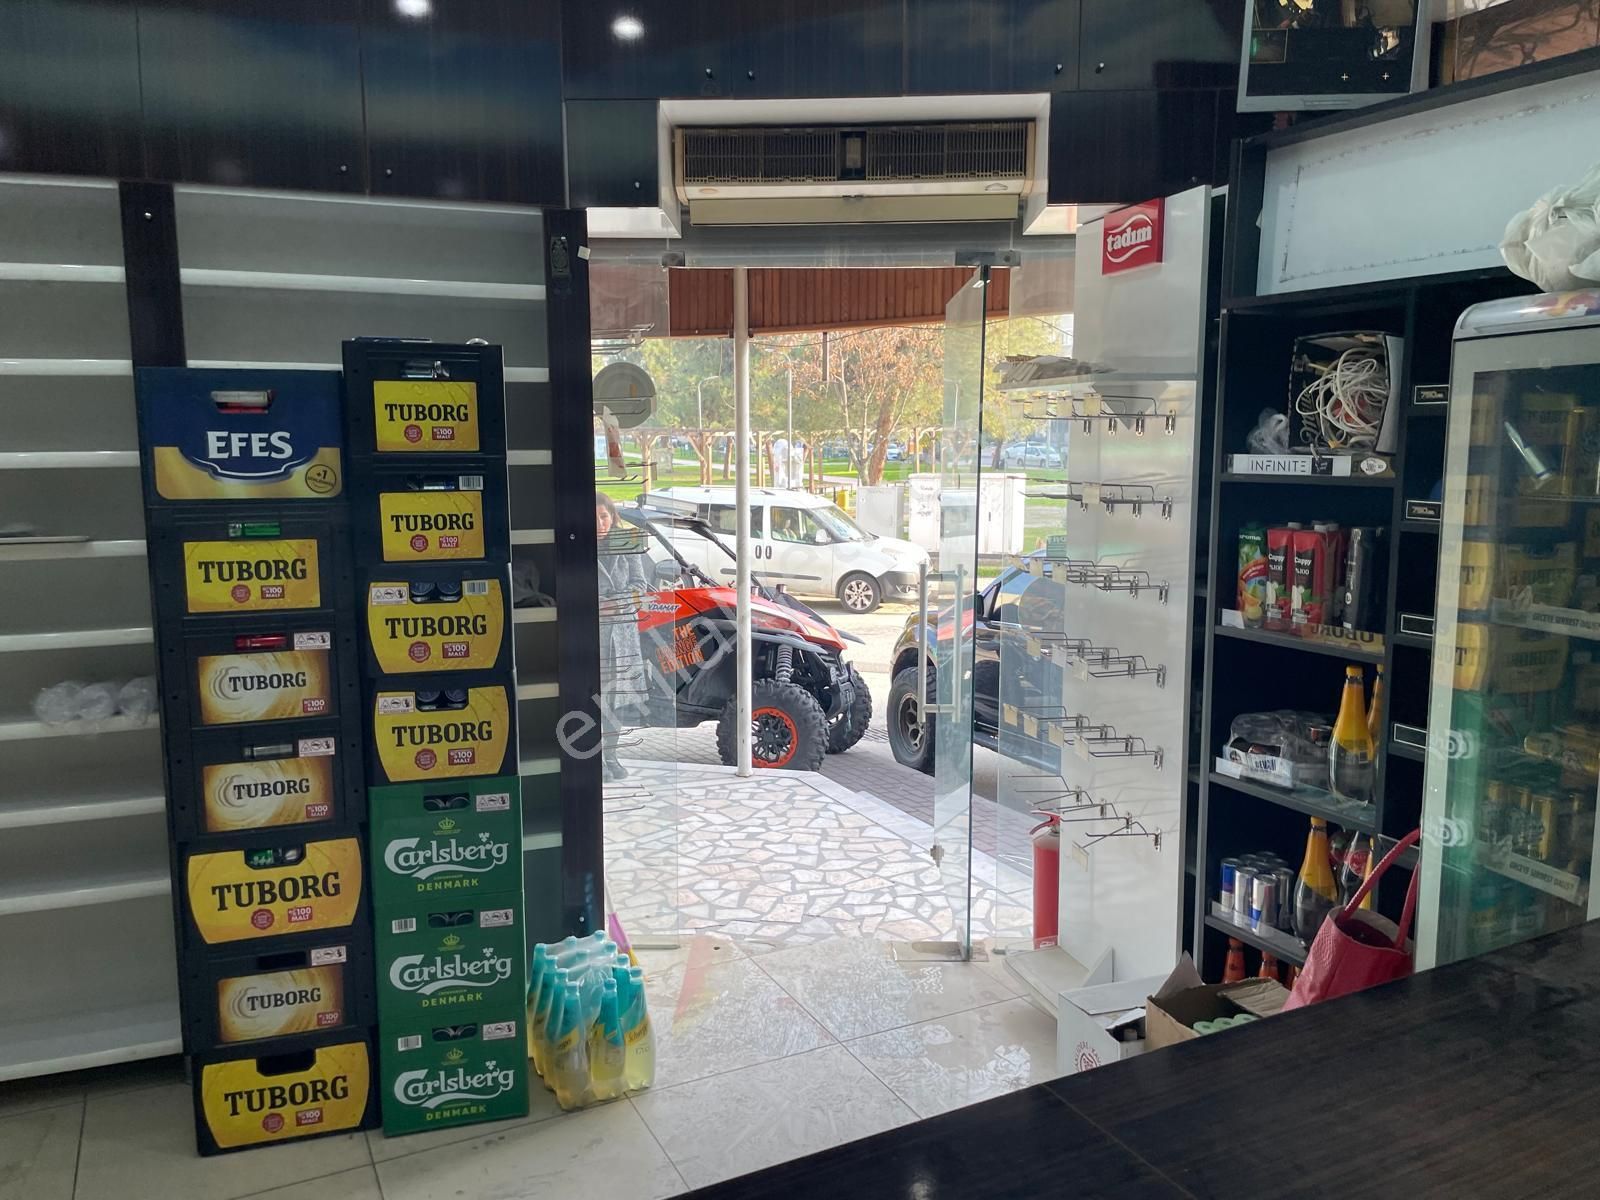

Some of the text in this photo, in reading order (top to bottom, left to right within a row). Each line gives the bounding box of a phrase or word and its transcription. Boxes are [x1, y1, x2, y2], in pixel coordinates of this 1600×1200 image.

[1106, 226, 1153, 253] tadım
[384, 403, 469, 422] TUBORG
[207, 431, 293, 459] EFES
[1250, 460, 1306, 473] INFINITE
[391, 512, 474, 533] TUBORG
[1268, 553, 1285, 563] Cappy
[1294, 557, 1312, 567] Cappy
[198, 558, 307, 584] TUBORG
[385, 614, 487, 640] TUBORG
[673, 622, 696, 641] THE
[229, 671, 307, 693] TUBORG
[391, 720, 493, 747] TUBORG
[233, 778, 310, 800] TUBORG
[384, 836, 509, 879] Carlsberg
[211, 871, 341, 912] TUBORG
[416, 878, 479, 892] DENMARK
[389, 953, 512, 995] Carlsberg
[247, 987, 321, 1011] TUBORG
[421, 992, 483, 1008] DENMARK
[224, 1074, 349, 1117] TUBORG
[394, 1068, 515, 1109] Carlsberg
[425, 1104, 487, 1121] DENMARK
